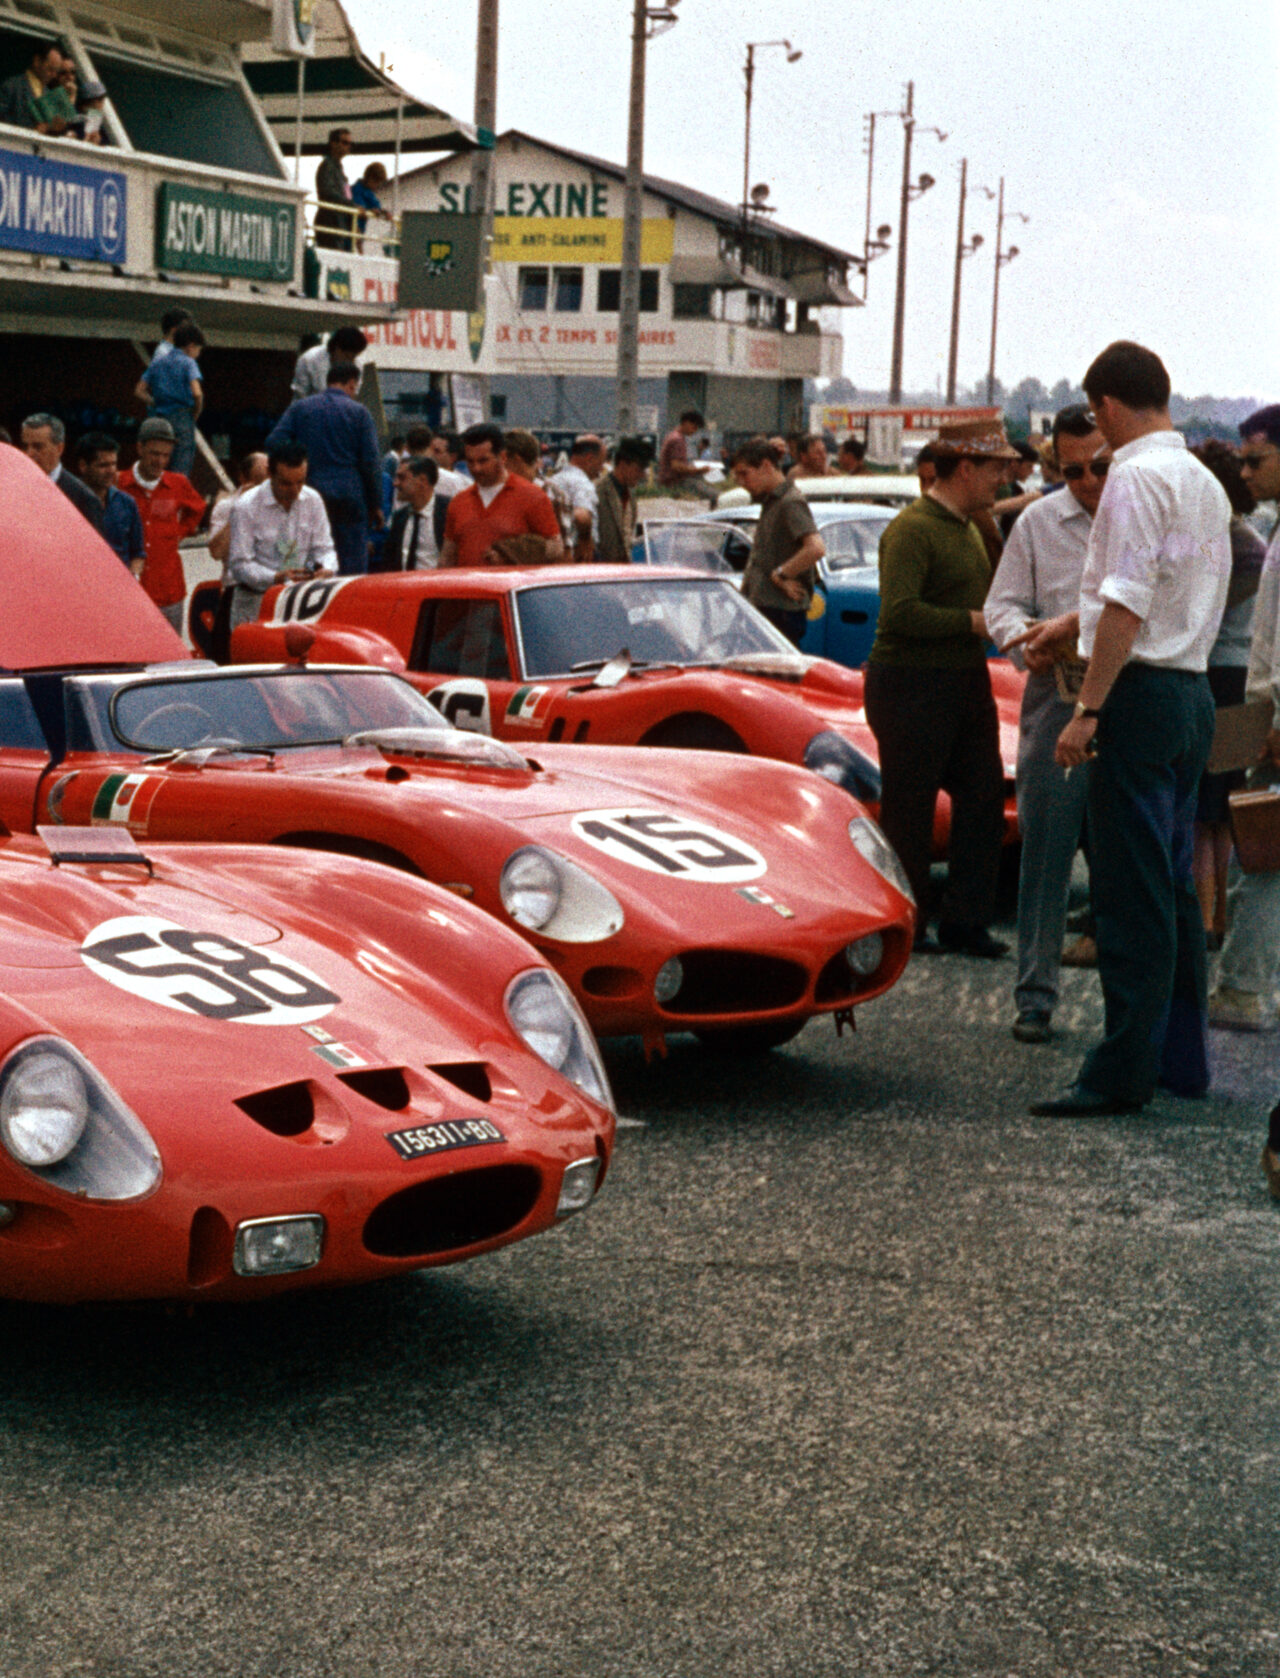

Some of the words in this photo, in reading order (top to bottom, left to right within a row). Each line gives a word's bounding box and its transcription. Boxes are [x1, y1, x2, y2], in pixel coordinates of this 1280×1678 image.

[25, 175, 96, 240] MARTIN
[102, 194, 118, 239] 12
[438, 182, 608, 217] SEXINE
[165, 200, 217, 255] ASTON
[219, 208, 273, 263] MARTIN
[429, 242, 451, 261] BP
[539, 325, 551, 344] 2
[556, 328, 597, 345] TEMPS
[604, 329, 676, 346] SIAIRES
[577, 814, 759, 874] 15
[79, 929, 342, 1020] 58
